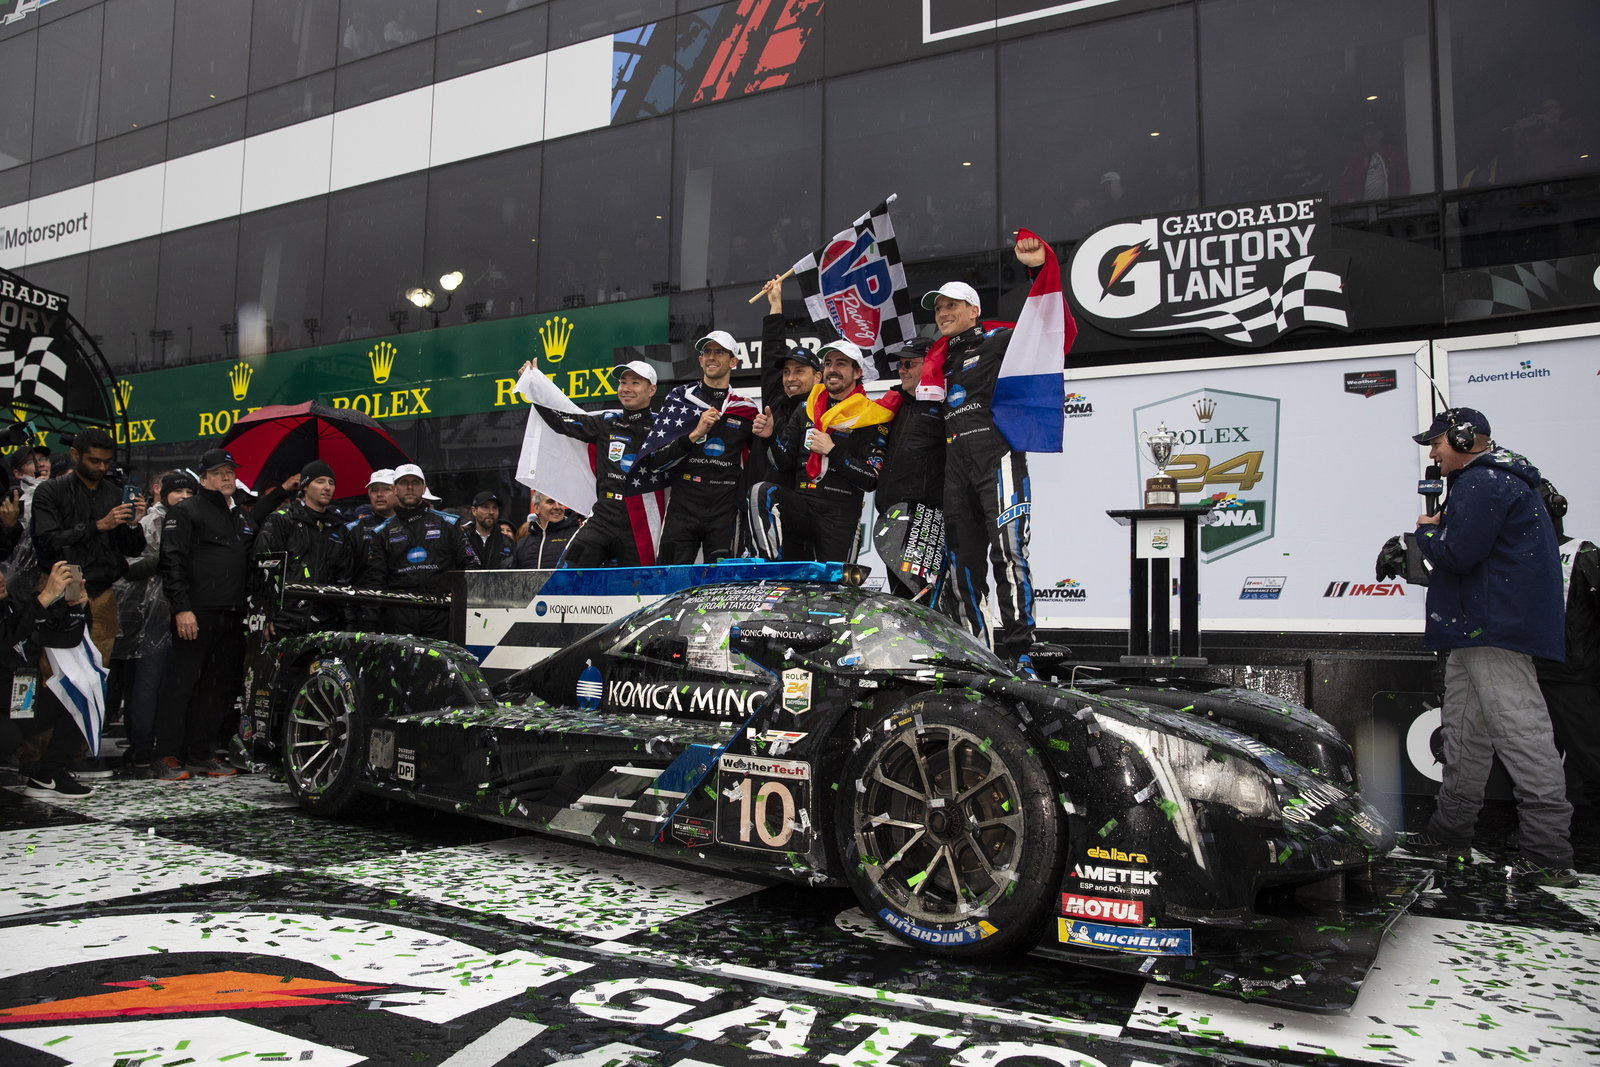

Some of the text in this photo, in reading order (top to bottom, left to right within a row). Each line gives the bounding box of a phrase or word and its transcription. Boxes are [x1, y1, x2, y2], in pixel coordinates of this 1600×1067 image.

[1162, 199, 1314, 236] GATORADE
[5, 212, 88, 250] Motorsport
[1163, 224, 1316, 270] VICTORY
[0, 279, 60, 311] RADE
[1167, 265, 1257, 303] LANE
[494, 367, 618, 406] REX
[199, 409, 263, 436] ROL
[1163, 451, 1265, 493] 24
[1203, 510, 1258, 527] ONA
[1034, 589, 1086, 598] DAYTONA
[1349, 584, 1405, 596] IMSA
[550, 605, 613, 614] KONICA MINOLTA
[728, 602, 761, 610] TAYLOR
[740, 629, 766, 637] KONIC
[608, 680, 682, 712] KONICA
[786, 682, 808, 694] 24
[400, 764, 414, 778] DPi
[728, 777, 796, 847] 10
[1087, 846, 1149, 864] dallara
[1070, 863, 1158, 886] AMETEK
[1080, 882, 1093, 890] ESP
[1095, 884, 1107, 892] and
[1065, 896, 1140, 921] MOTUL
[885, 913, 964, 943] MICHELIN
[1094, 931, 1180, 948] MICHELIN
